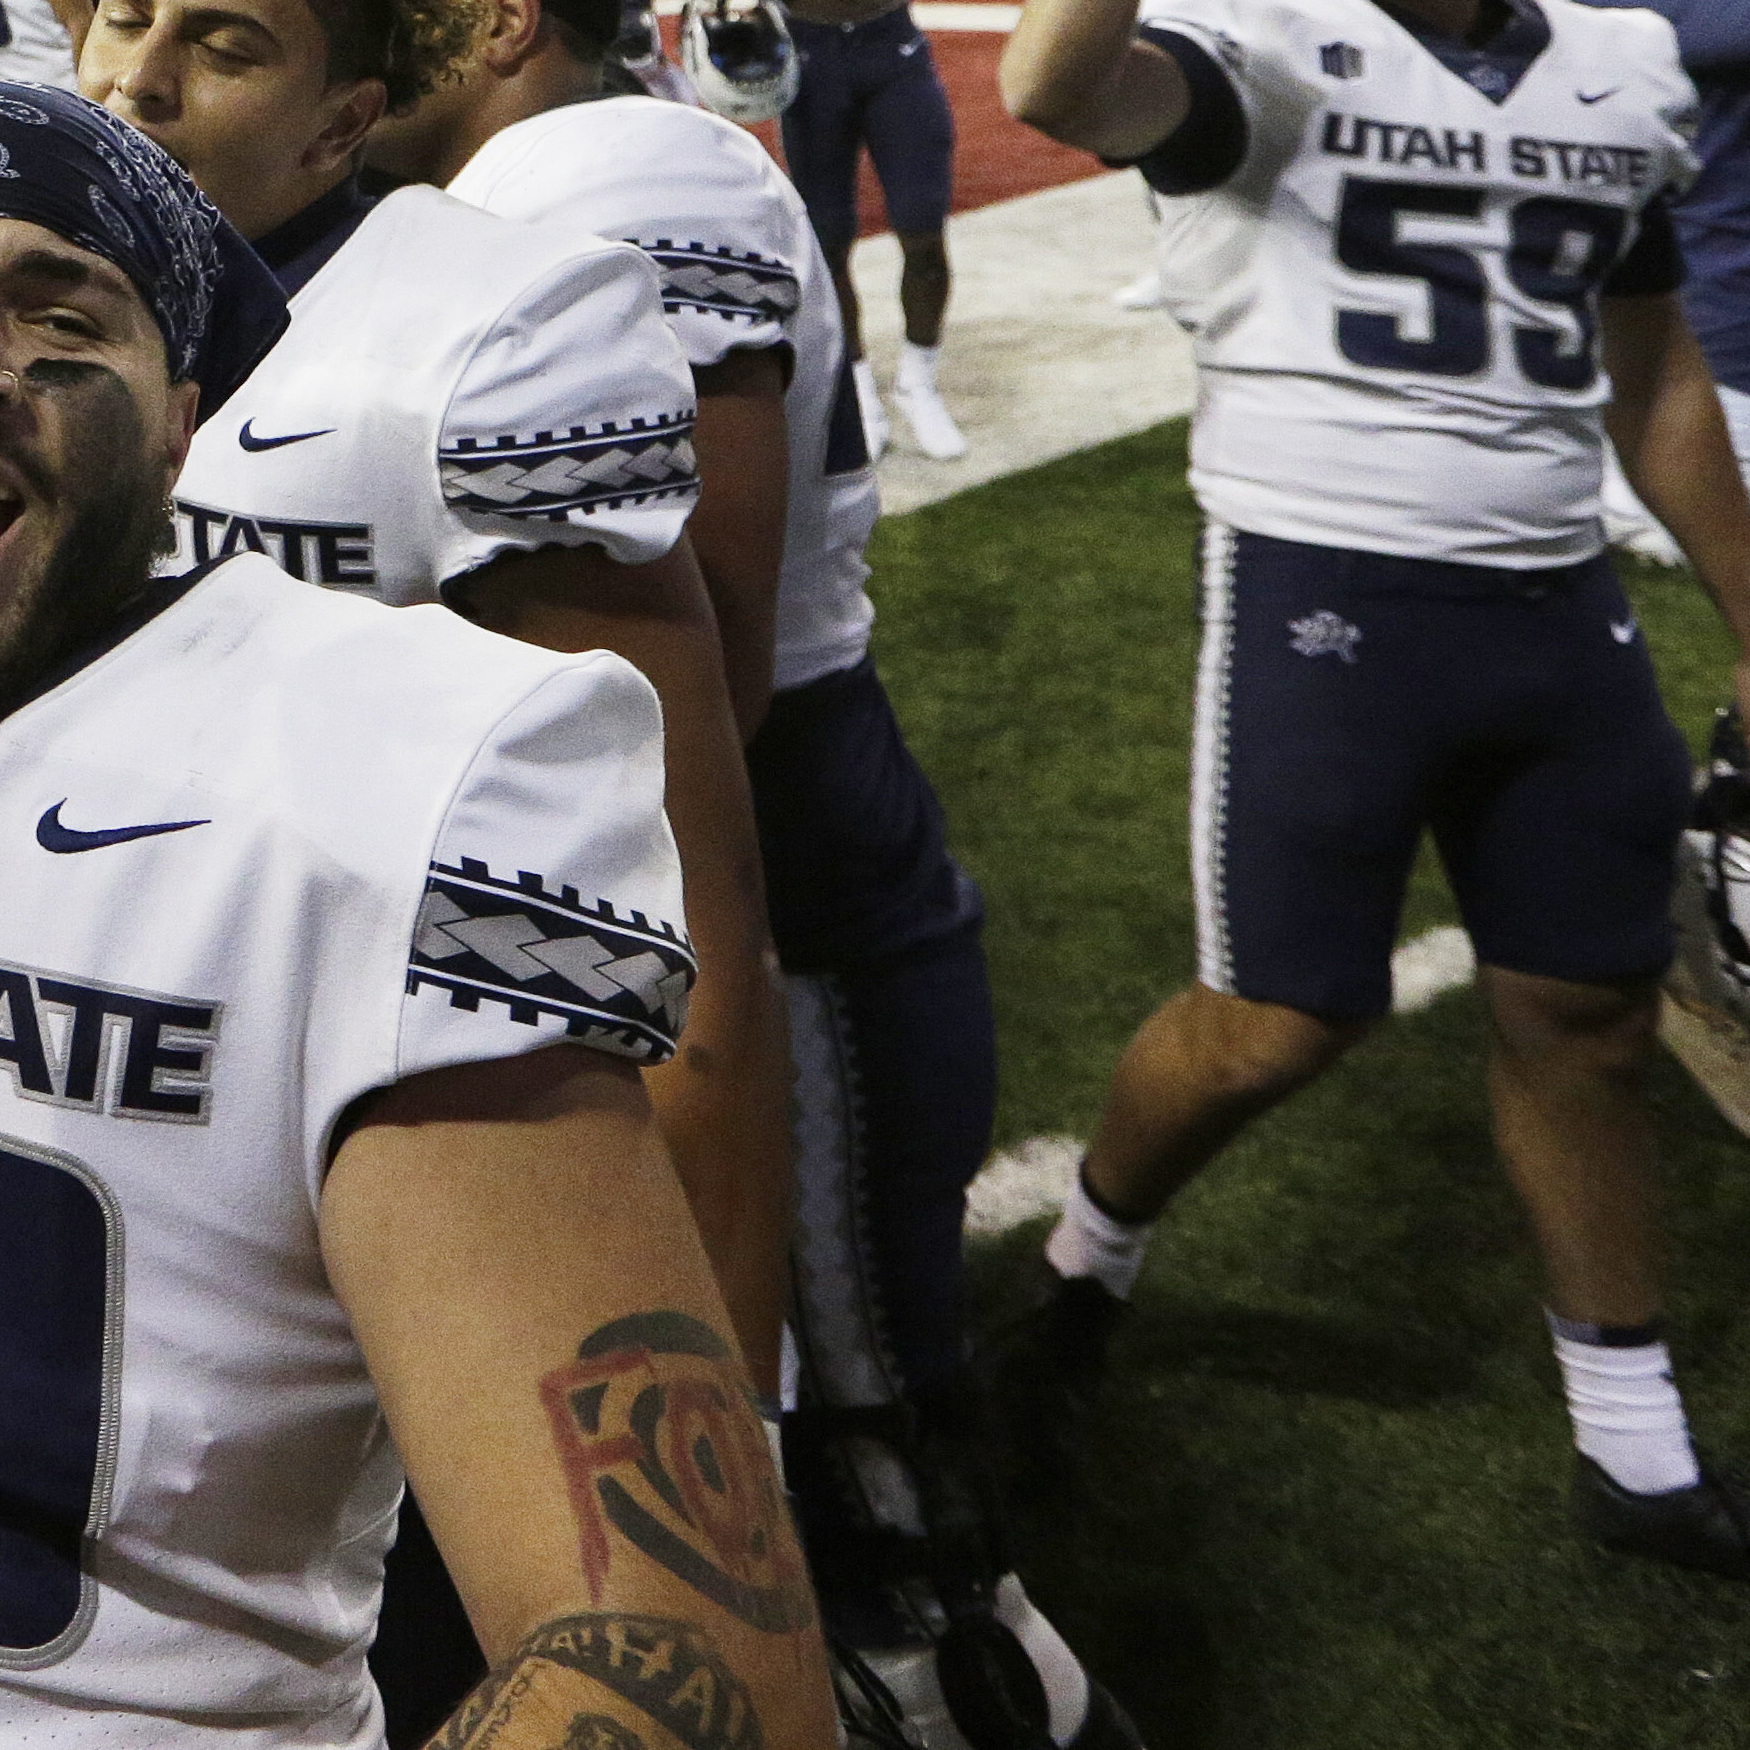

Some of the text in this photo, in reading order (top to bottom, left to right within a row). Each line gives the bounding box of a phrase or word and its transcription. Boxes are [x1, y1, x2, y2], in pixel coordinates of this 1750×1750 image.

[1324, 112, 1649, 188] UTAH STATE
[1335, 175, 1626, 393] 59
[171, 497, 376, 588] TATE
